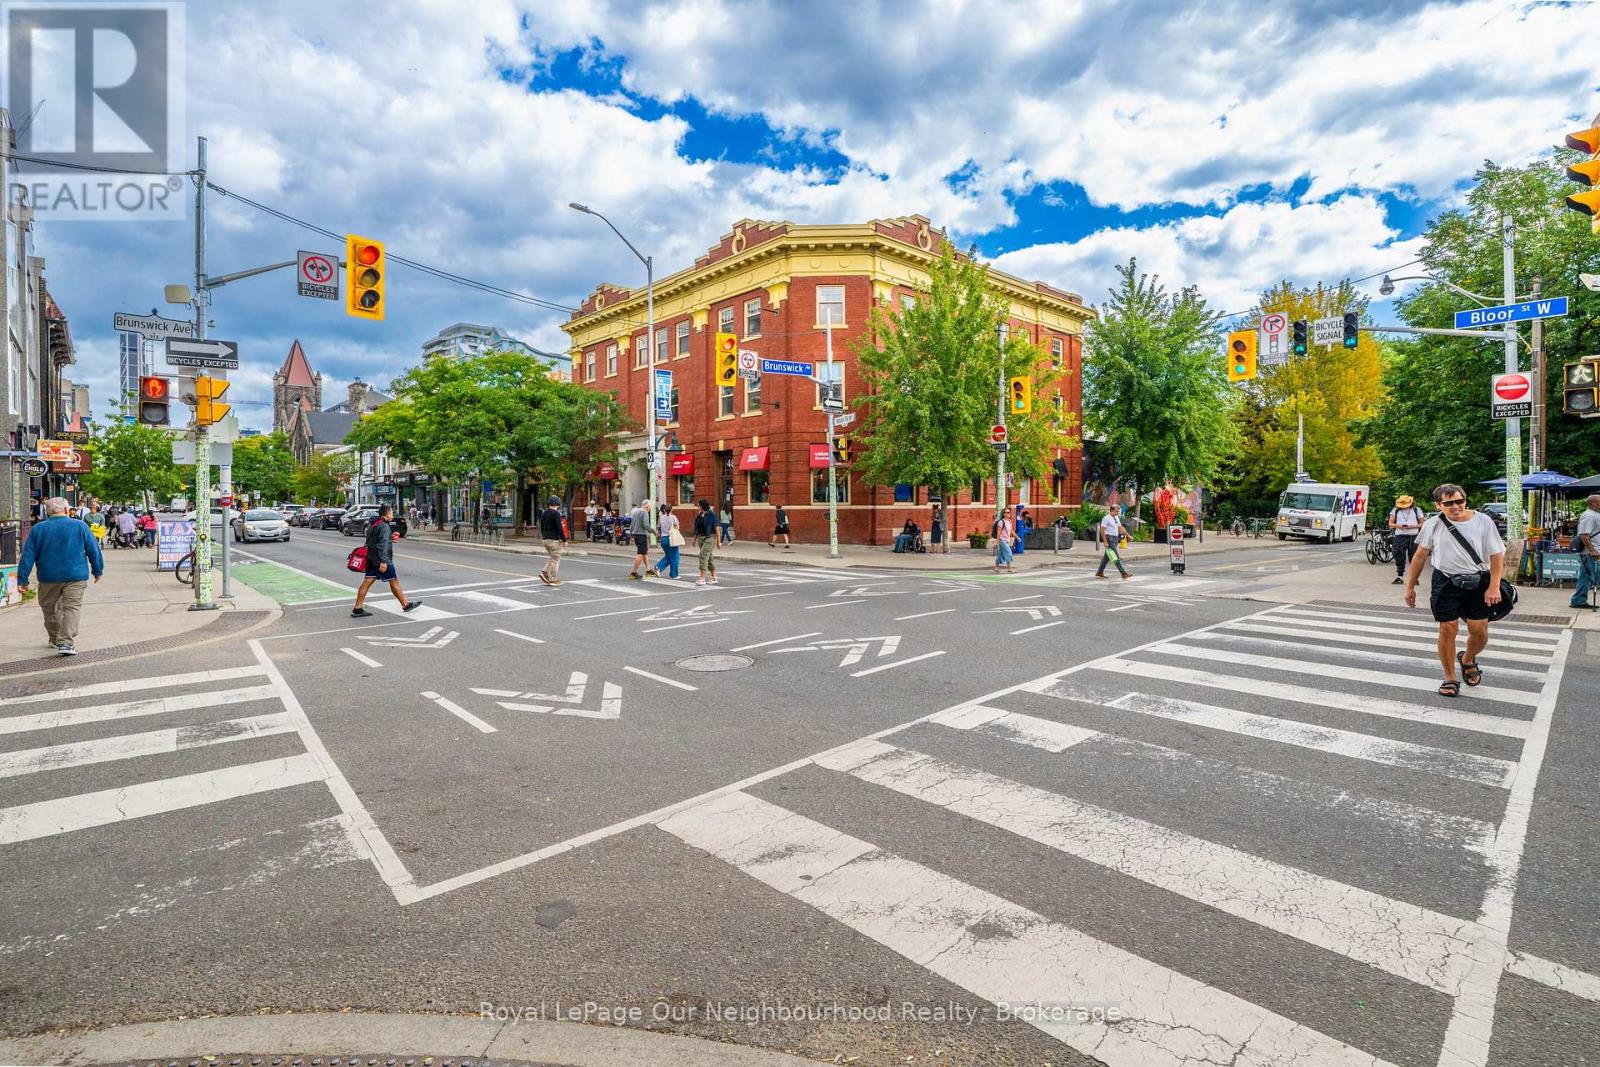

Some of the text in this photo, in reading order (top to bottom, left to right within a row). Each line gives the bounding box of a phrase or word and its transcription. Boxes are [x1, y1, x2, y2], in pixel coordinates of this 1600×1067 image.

[301, 289, 335, 299] EXCEPTED
[1471, 309, 1514, 324] Bloor
[1537, 302, 1551, 314] W
[116, 316, 191, 334] Brunswick Ave
[1315, 320, 1344, 331] BICYCLE
[1316, 331, 1343, 341] SIGNAL
[167, 358, 239, 368] BICYCLES EXCEPTED
[764, 361, 804, 373] Brunswick
[1495, 409, 1530, 417] EXCEPTED
[1343, 490, 1367, 516] FedEx
[161, 523, 197, 535] TAX
